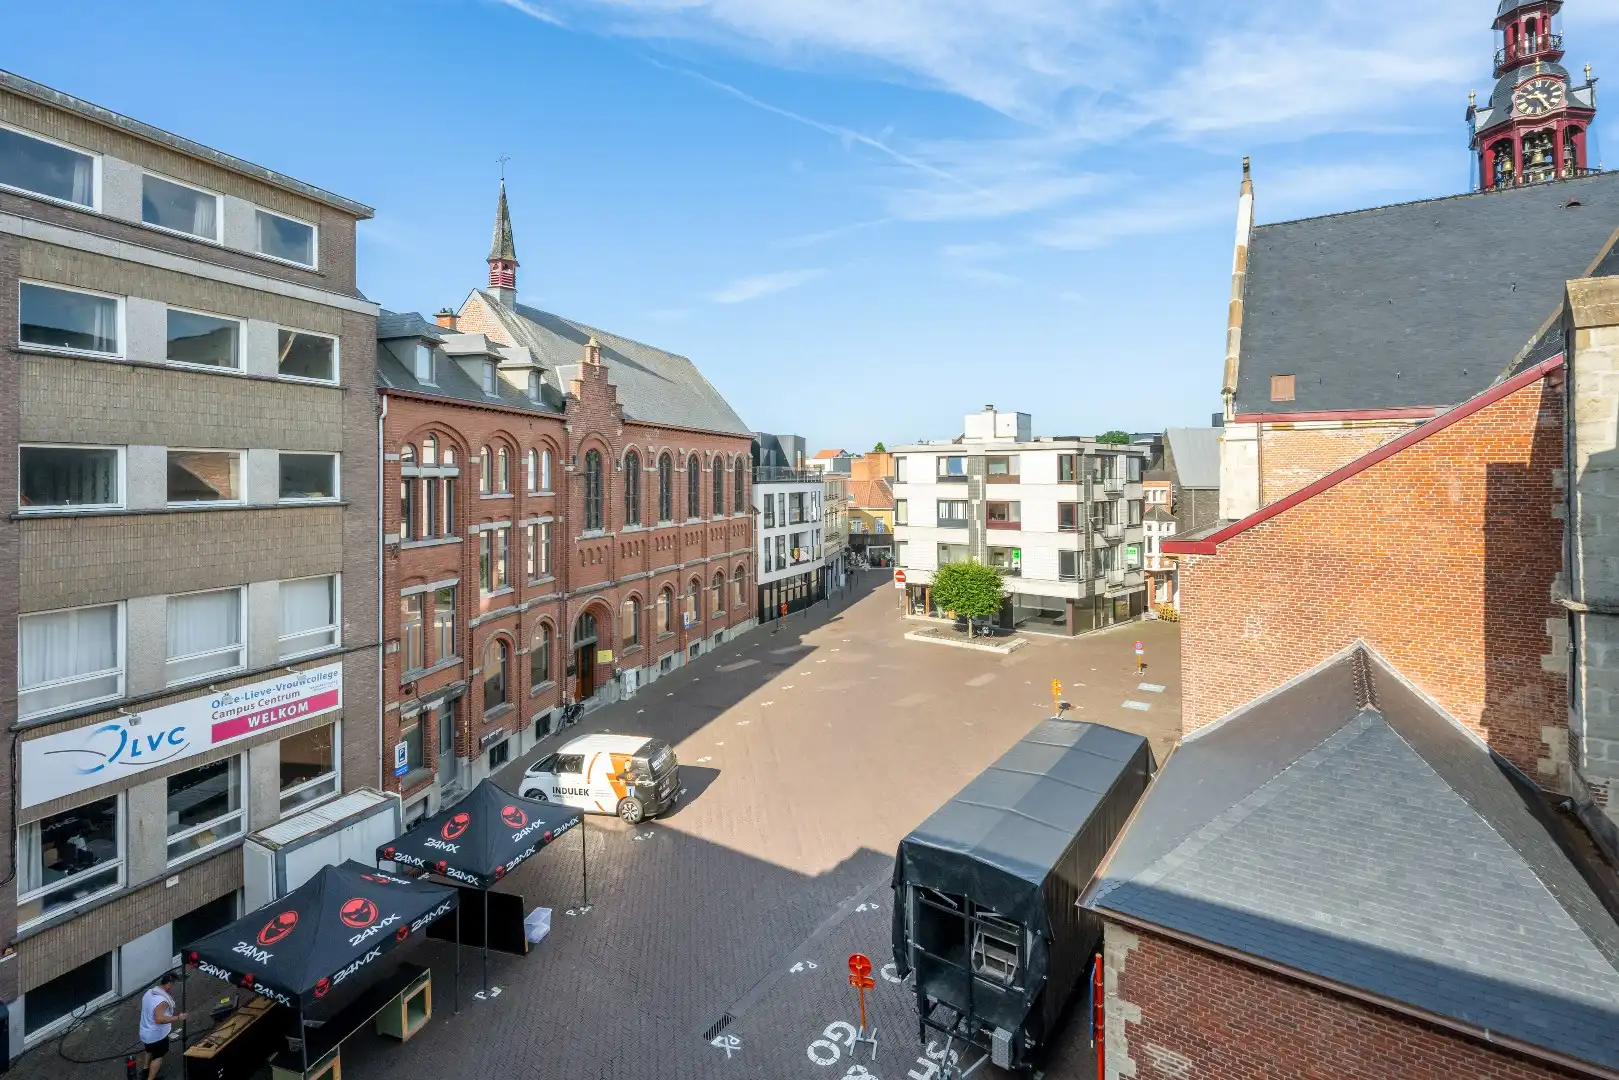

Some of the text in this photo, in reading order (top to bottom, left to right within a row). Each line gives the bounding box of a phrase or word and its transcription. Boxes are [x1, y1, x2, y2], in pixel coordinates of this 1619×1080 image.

[211, 670, 338, 709] Oe-Lieve-Vroucollege
[211, 690, 300, 720] Campus Centrum
[247, 701, 309, 728] WELKOM
[552, 786, 590, 797] INDULEK
[511, 818, 546, 843] 24MX
[553, 815, 580, 838] 24MX
[424, 837, 461, 854] 24MX
[394, 852, 425, 868] 24MX
[506, 845, 536, 872] 24MX
[447, 867, 480, 886] 24MX
[349, 912, 401, 947] 24MX
[411, 901, 451, 933] 24MX
[232, 941, 274, 965] 24MX
[333, 945, 382, 985] 24MX
[198, 961, 232, 982] 24MX
[254, 983, 291, 1007] 24MX
[807, 1020, 857, 1066] GO
